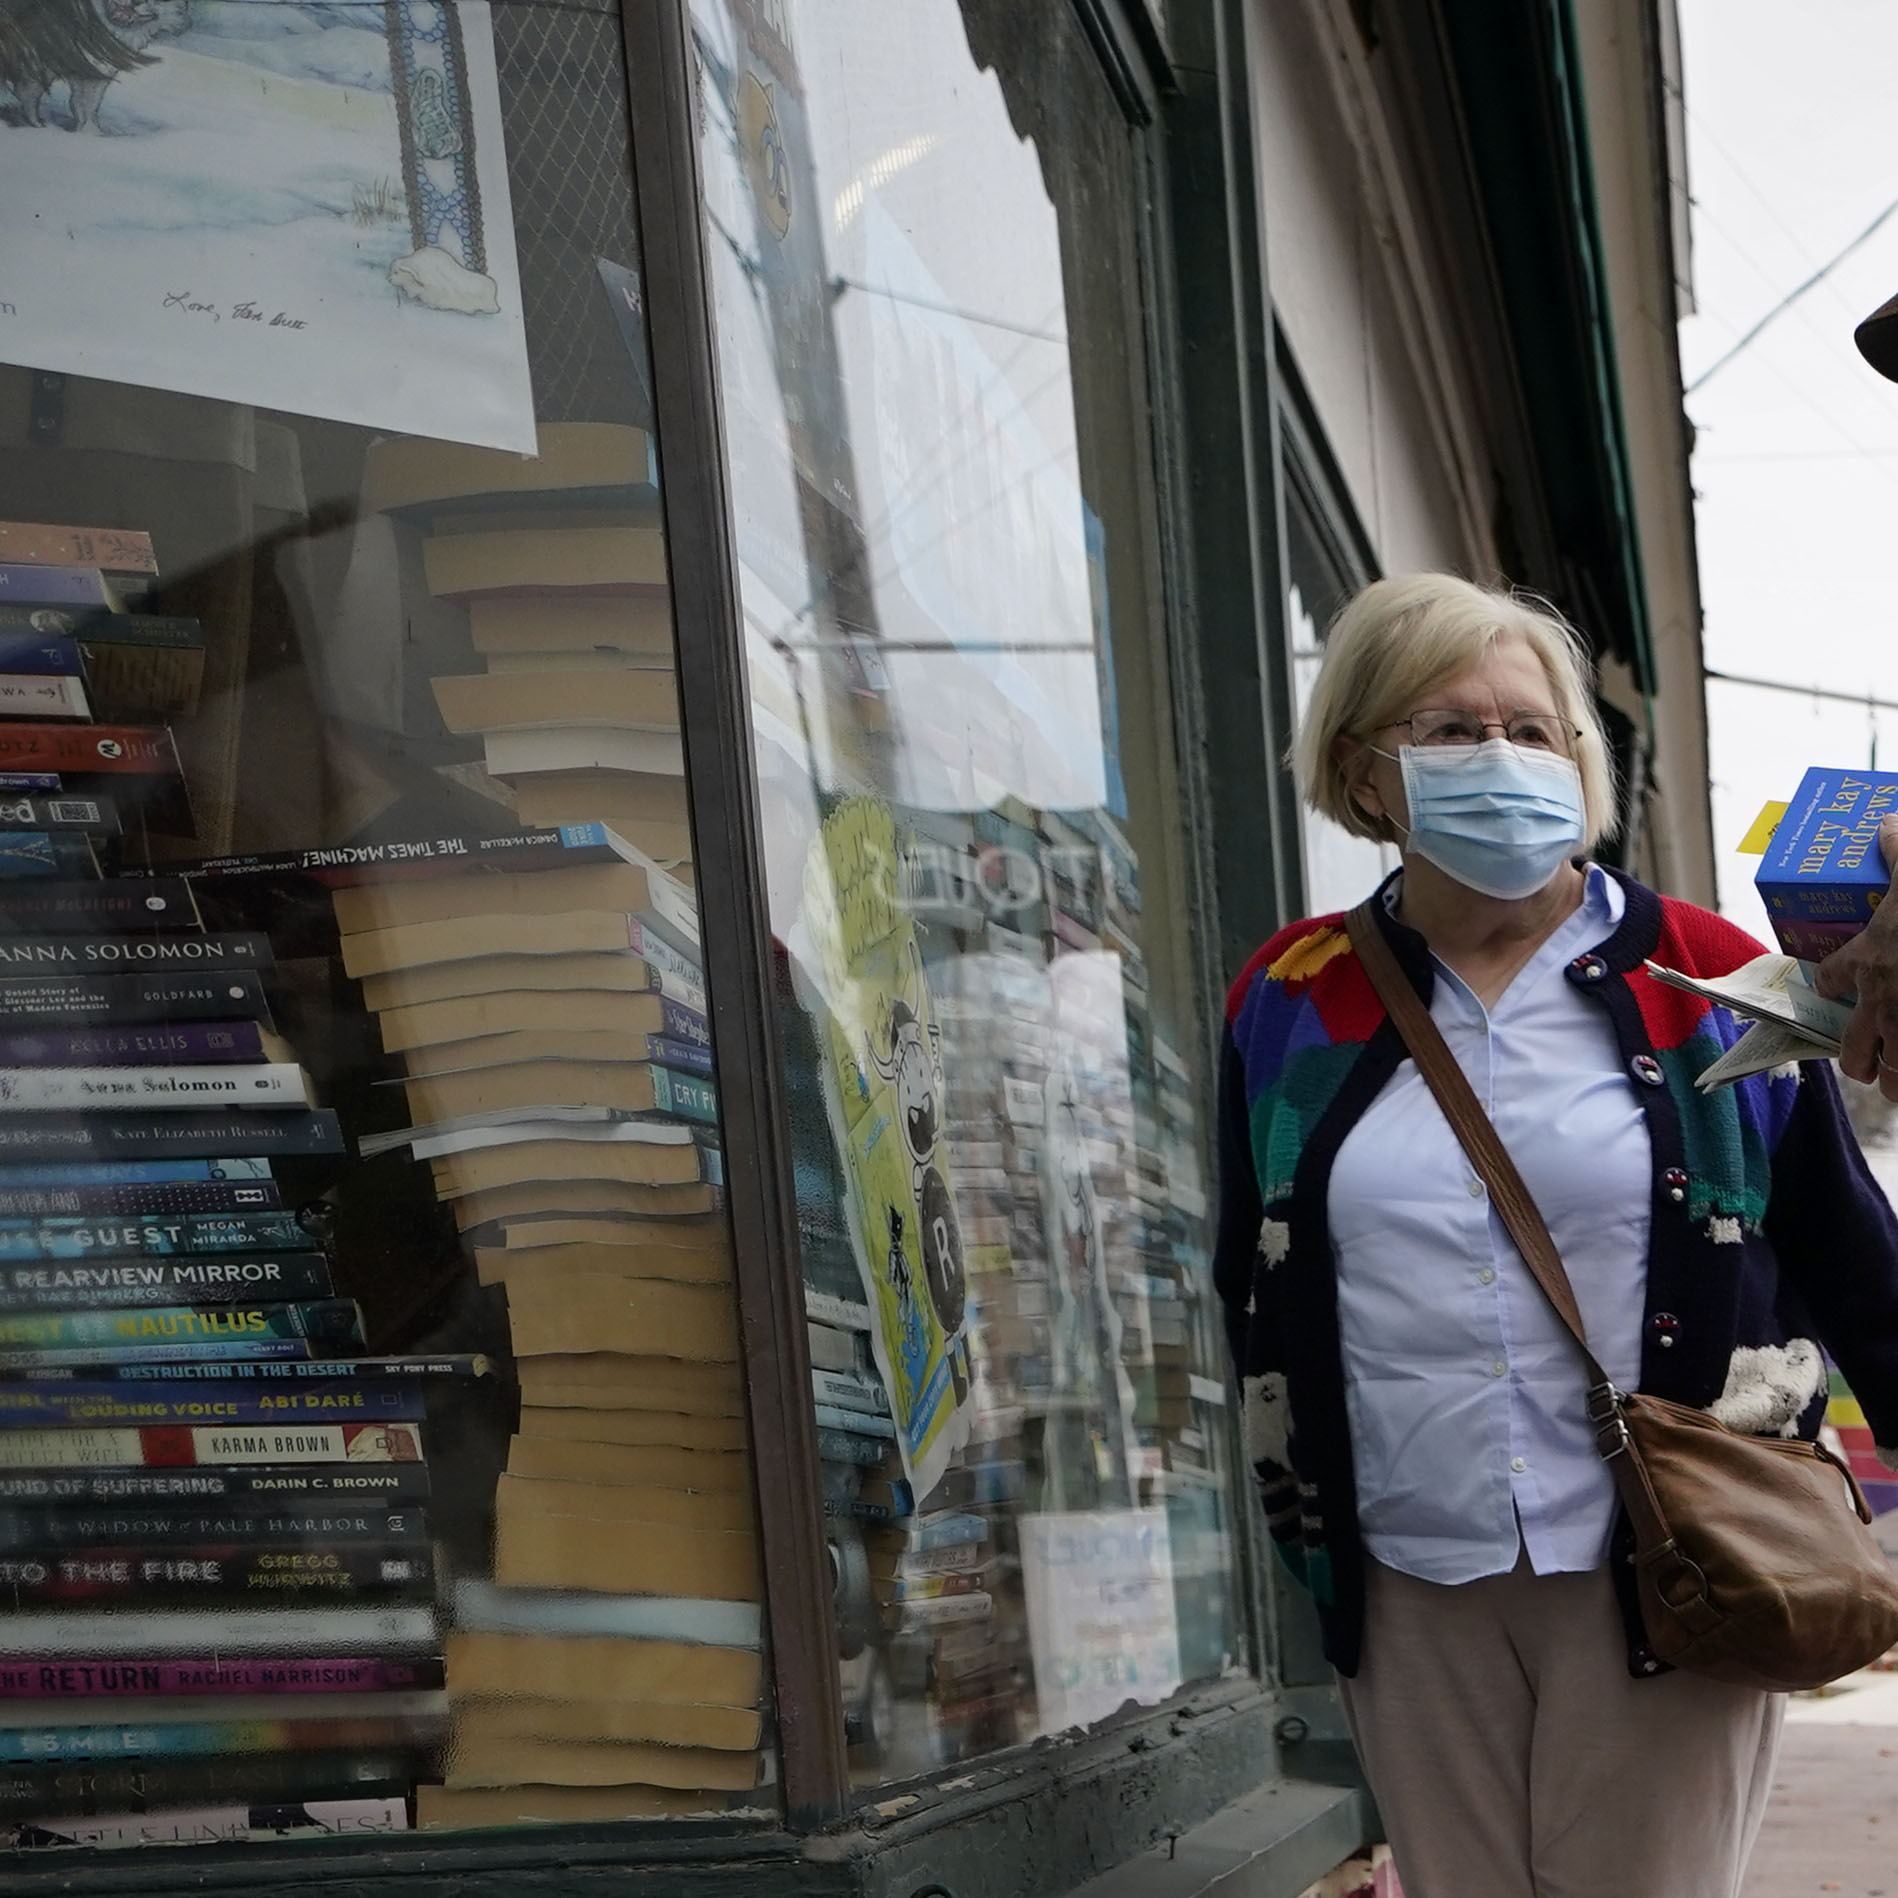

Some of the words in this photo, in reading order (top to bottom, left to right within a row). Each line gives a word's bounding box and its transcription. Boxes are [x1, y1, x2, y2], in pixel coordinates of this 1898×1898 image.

[1818, 776, 1873, 815] kay
[1836, 784, 1898, 870] andrews
[386, 840, 435, 860] TIMES
[437, 837, 468, 856] THE
[1798, 821, 1850, 875] mary
[301, 846, 385, 870] MACHINE!
[86, 940, 225, 961] SOLOMON
[196, 1220, 247, 1232] MEGAN
[70, 1225, 183, 1248] GUEST
[192, 1233, 257, 1247] MIRANDA
[932, 1215, 957, 1292] R
[14, 1266, 165, 1289] REARVIEW
[172, 1263, 282, 1286] MIRROR
[114, 1310, 268, 1337] NAUTILUS
[118, 1365, 233, 1379] DESTRUCTION
[237, 1365, 255, 1377] IN
[261, 1364, 293, 1377] THE
[296, 1363, 357, 1377] DESERT
[173, 1402, 240, 1416] VOICE
[258, 1395, 300, 1409] ABI
[211, 1435, 268, 1454] KARMA
[275, 1434, 331, 1453] BROWN
[92, 1477, 226, 1496] SUFFERING
[251, 1478, 308, 1490] DARIN
[312, 1478, 329, 1489] C.
[332, 1476, 400, 1489] BROWN
[268, 1518, 369, 1534] HARBOR
[39, 1665, 161, 1692] RETURN
[178, 1669, 255, 1686] RACHEL
[260, 1668, 363, 1685] HARRISON
